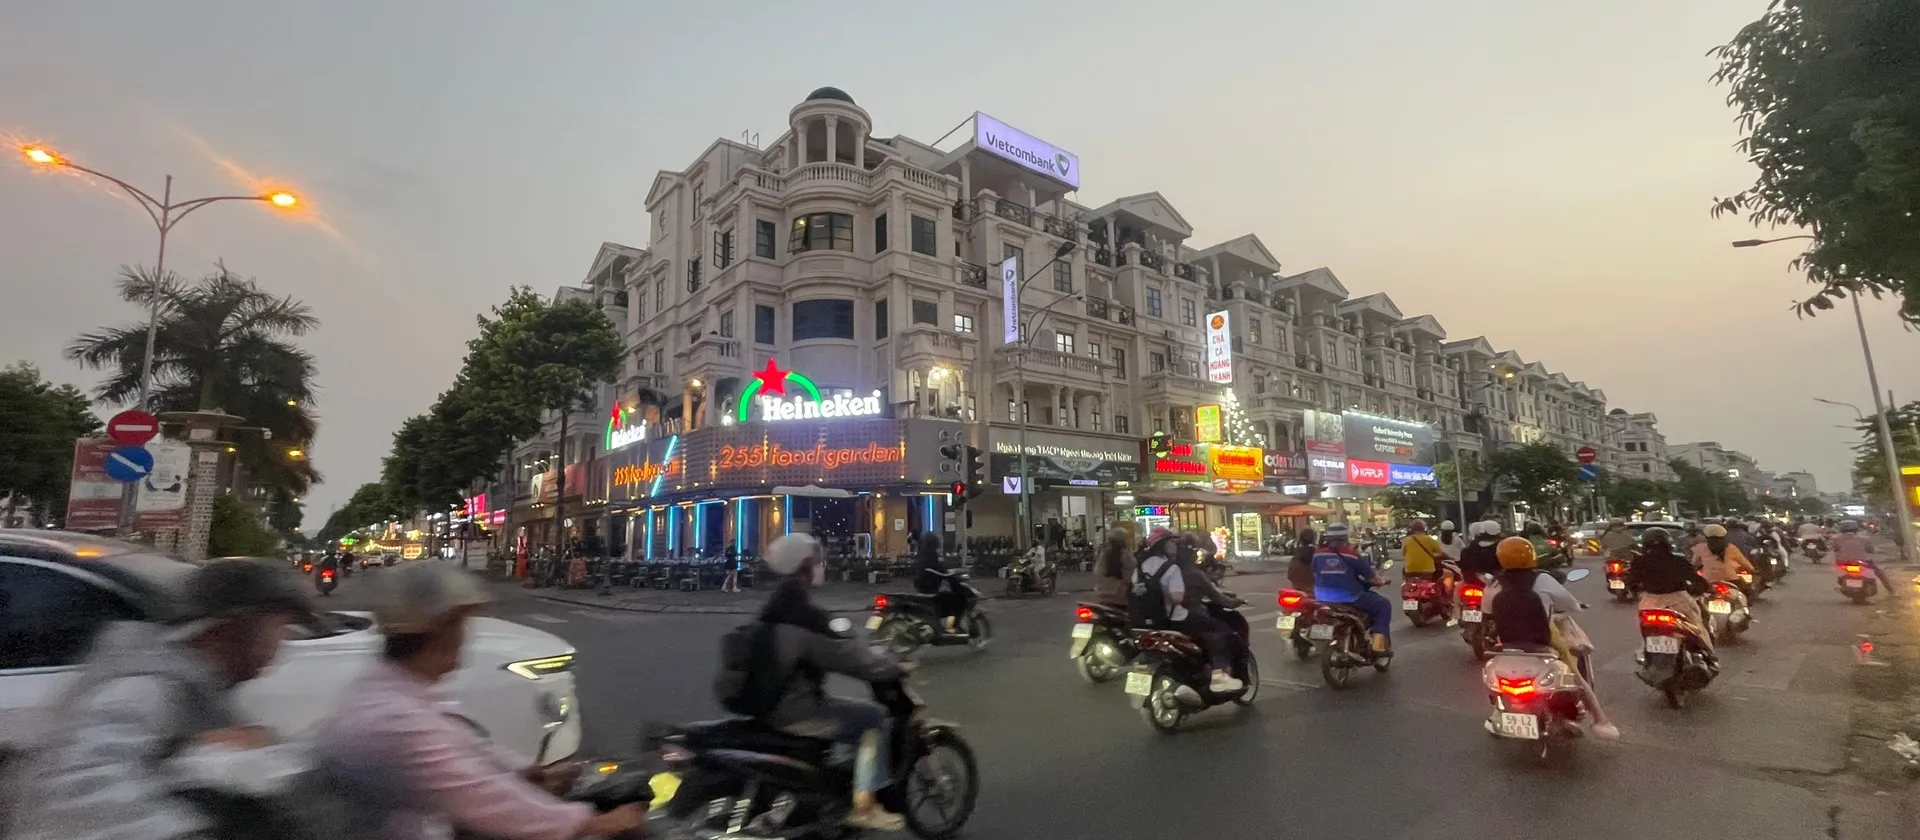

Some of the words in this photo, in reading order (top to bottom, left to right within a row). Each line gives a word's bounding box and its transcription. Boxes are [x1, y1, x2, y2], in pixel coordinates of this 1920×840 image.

[986, 131, 1055, 172] Vietcombank
[1010, 280, 1018, 333] Vietcombank
[761, 391, 881, 421] Heineken
[720, 444, 762, 469] 255
[769, 443, 820, 466] food
[821, 443, 902, 470] garden
[1037, 445, 1059, 456] TMCP
